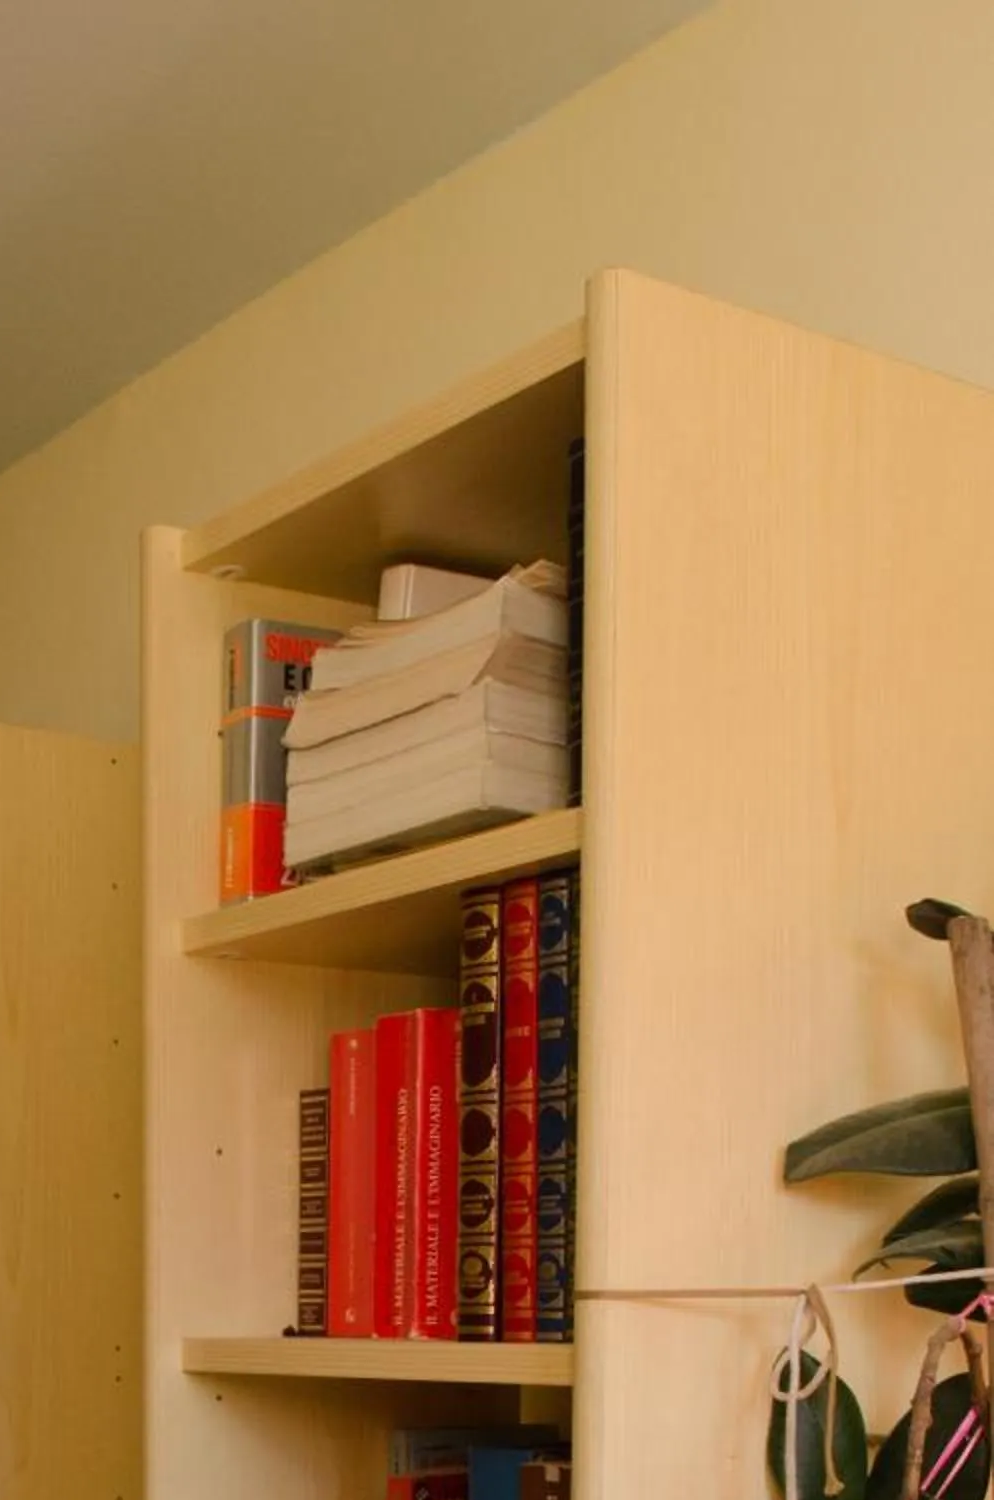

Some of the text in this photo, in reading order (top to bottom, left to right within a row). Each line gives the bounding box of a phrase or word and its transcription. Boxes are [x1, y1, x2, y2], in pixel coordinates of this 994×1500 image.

[284, 664, 296, 690] E
[427, 1211, 440, 1219] E
[394, 1224, 406, 1308] MATERIALE
[425, 1222, 440, 1308] MATERIALE
